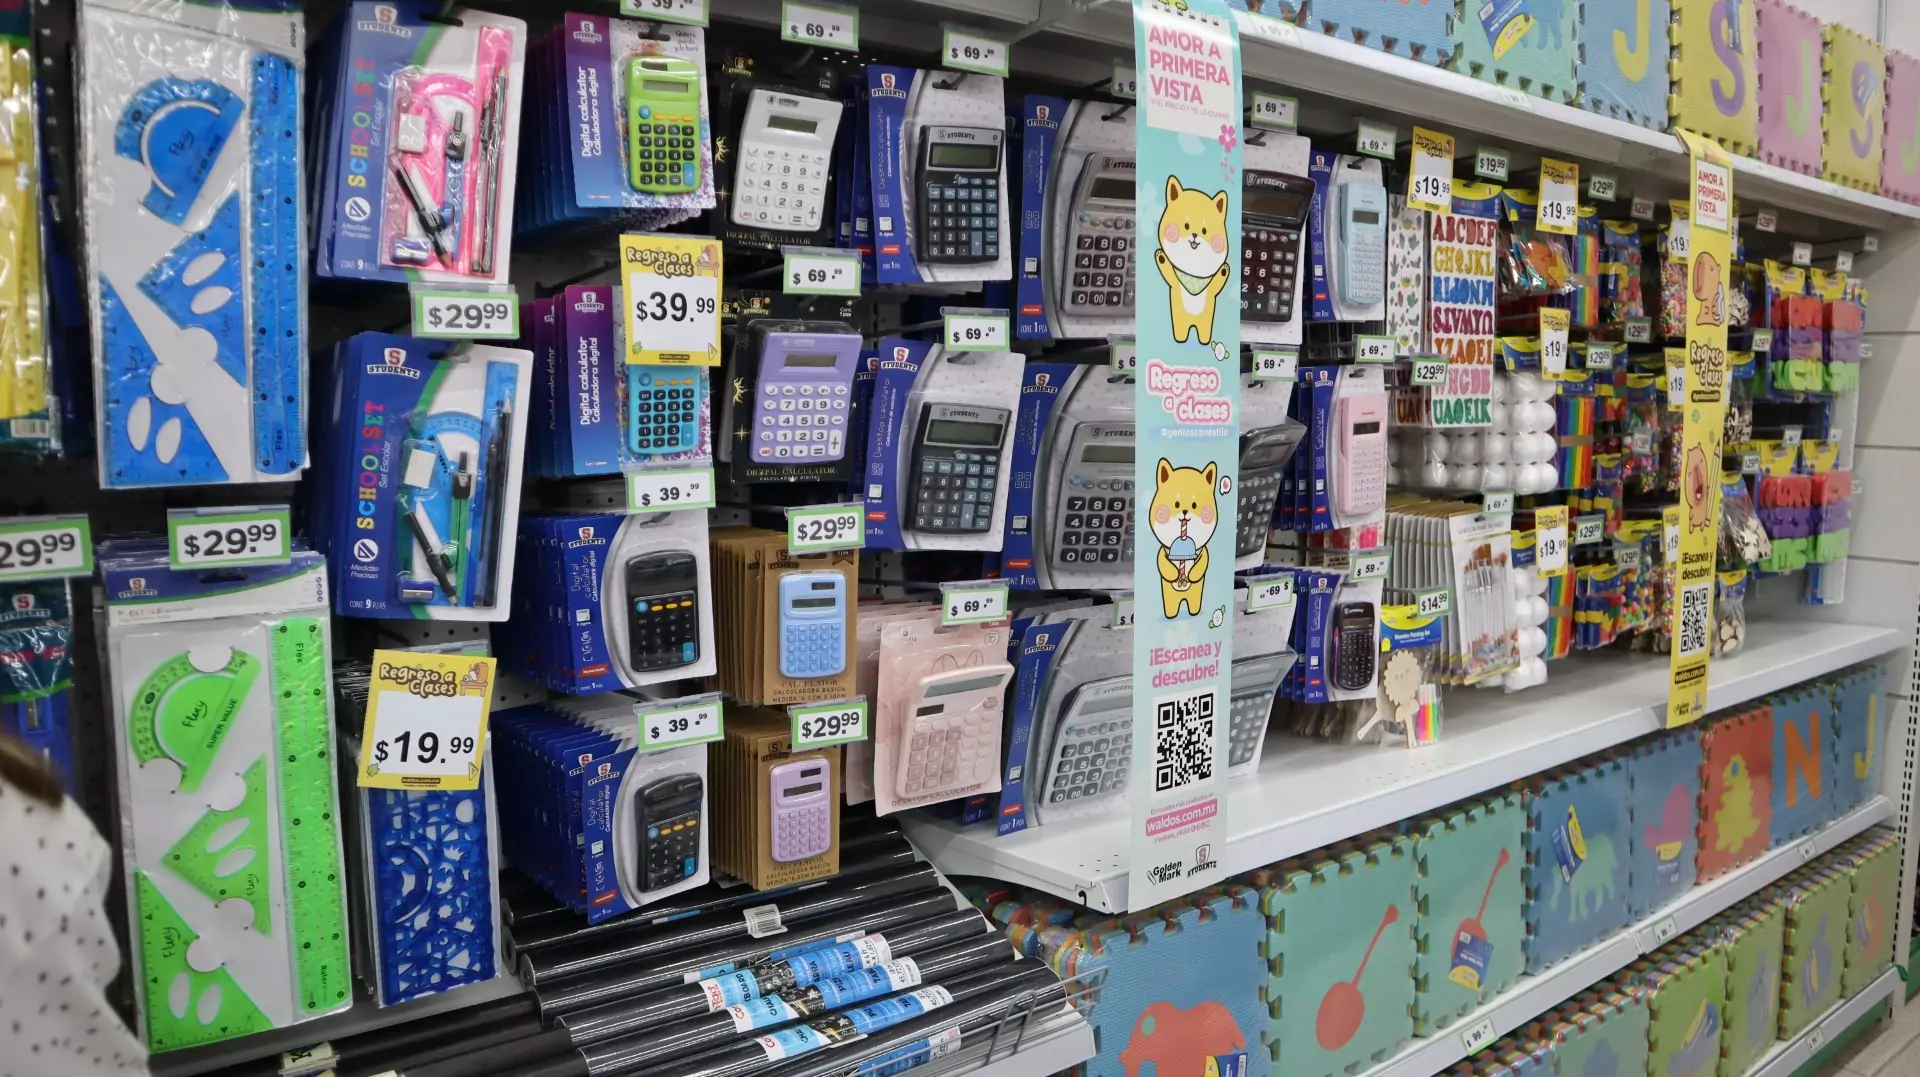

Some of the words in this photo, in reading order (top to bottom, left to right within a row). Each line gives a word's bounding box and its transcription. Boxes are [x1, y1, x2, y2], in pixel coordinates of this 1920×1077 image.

[1149, 25, 1204, 55] AMOR
[1208, 42, 1221, 59] A
[354, 57, 376, 95] SET
[1150, 49, 1230, 86] PRIMERA
[578, 66, 588, 121] calculator
[872, 87, 906, 99] STUDENTZ
[1150, 74, 1203, 105] VISTA
[1698, 170, 1717, 186] AMOR
[1719, 176, 1724, 187] A
[1698, 184, 1726, 202] PRIMERA
[1543, 201, 1576, 220] $19.99
[1698, 199, 1716, 214] VISTA
[1433, 214, 1497, 247] ABCDEF
[627, 247, 678, 265] Regreso
[679, 253, 691, 264] a
[655, 261, 693, 278] Clases
[428, 303, 508, 329] $29.99
[637, 291, 715, 322] $39.99
[1691, 341, 1723, 365] Regreso
[367, 364, 421, 379] STUDENTZ
[881, 361, 918, 372] STUDENTZ
[1417, 365, 1444, 380] $29.99
[1150, 365, 1218, 396] Regreso
[363, 401, 384, 439] SET
[950, 411, 979, 419] STUDENTZ
[1164, 398, 1174, 410] a
[1178, 396, 1229, 421] clases
[380, 440, 391, 471] Escolar
[357, 445, 380, 530] SCHOOL
[379, 471, 389, 488] Set
[184, 523, 277, 557] $29.99
[797, 515, 856, 542] $29.99
[0, 532, 76, 568] 29.99
[365, 599, 371, 609] 9
[1421, 593, 1447, 612] $14.99
[1149, 642, 1210, 667] ¡Escanea
[1214, 641, 1222, 657] y
[379, 663, 441, 683] Regreso
[443, 672, 455, 682] a
[1152, 660, 1219, 688] descubre!
[410, 679, 455, 697] Clases
[181, 700, 208, 729] Flexy
[206, 724, 223, 749] SUPER
[220, 697, 238, 725] VALUE
[802, 712, 860, 739] $29.99
[374, 730, 475, 764] $19.99
[1855, 694, 1877, 780] J
[1785, 711, 1823, 808] N
[1147, 803, 1216, 833] waldos.com.mx
[1153, 861, 1182, 876] Golden
[1159, 870, 1181, 883] Mark
[1187, 860, 1217, 878] STUDENTZ
